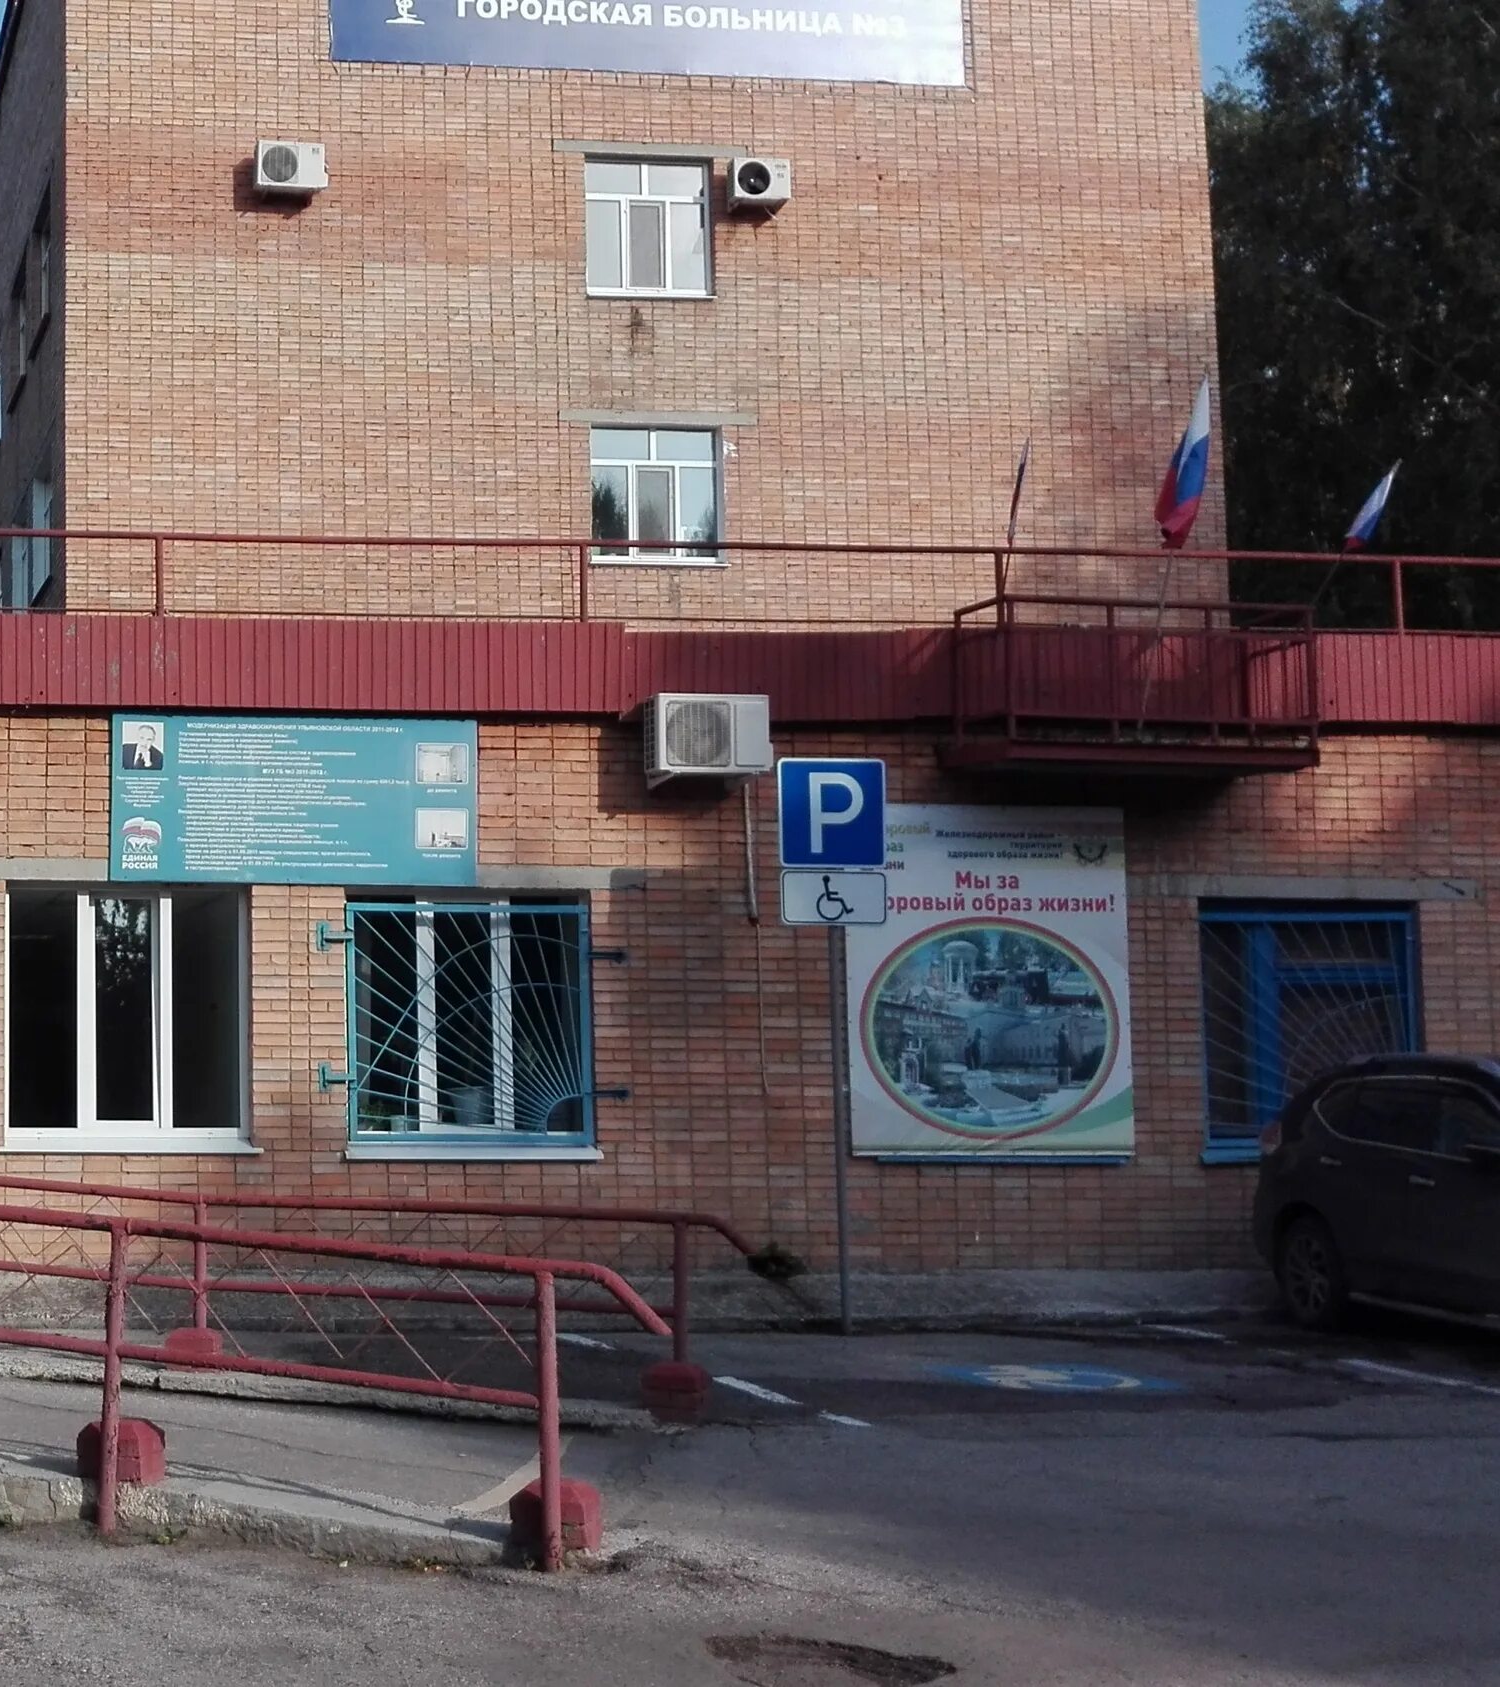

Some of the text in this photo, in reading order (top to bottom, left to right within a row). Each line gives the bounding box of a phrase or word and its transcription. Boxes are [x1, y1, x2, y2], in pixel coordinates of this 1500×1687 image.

[455, 0, 652, 26] ГОРОДСКАЯ
[663, 4, 843, 37] БОЛЬНИЦА
[808, 772, 864, 853] P
[121, 854, 158, 862] ЕДИНАЯ
[954, 871, 1020, 890] Мы за
[971, 893, 1033, 915] образ
[1038, 893, 1115, 912] жизни!
